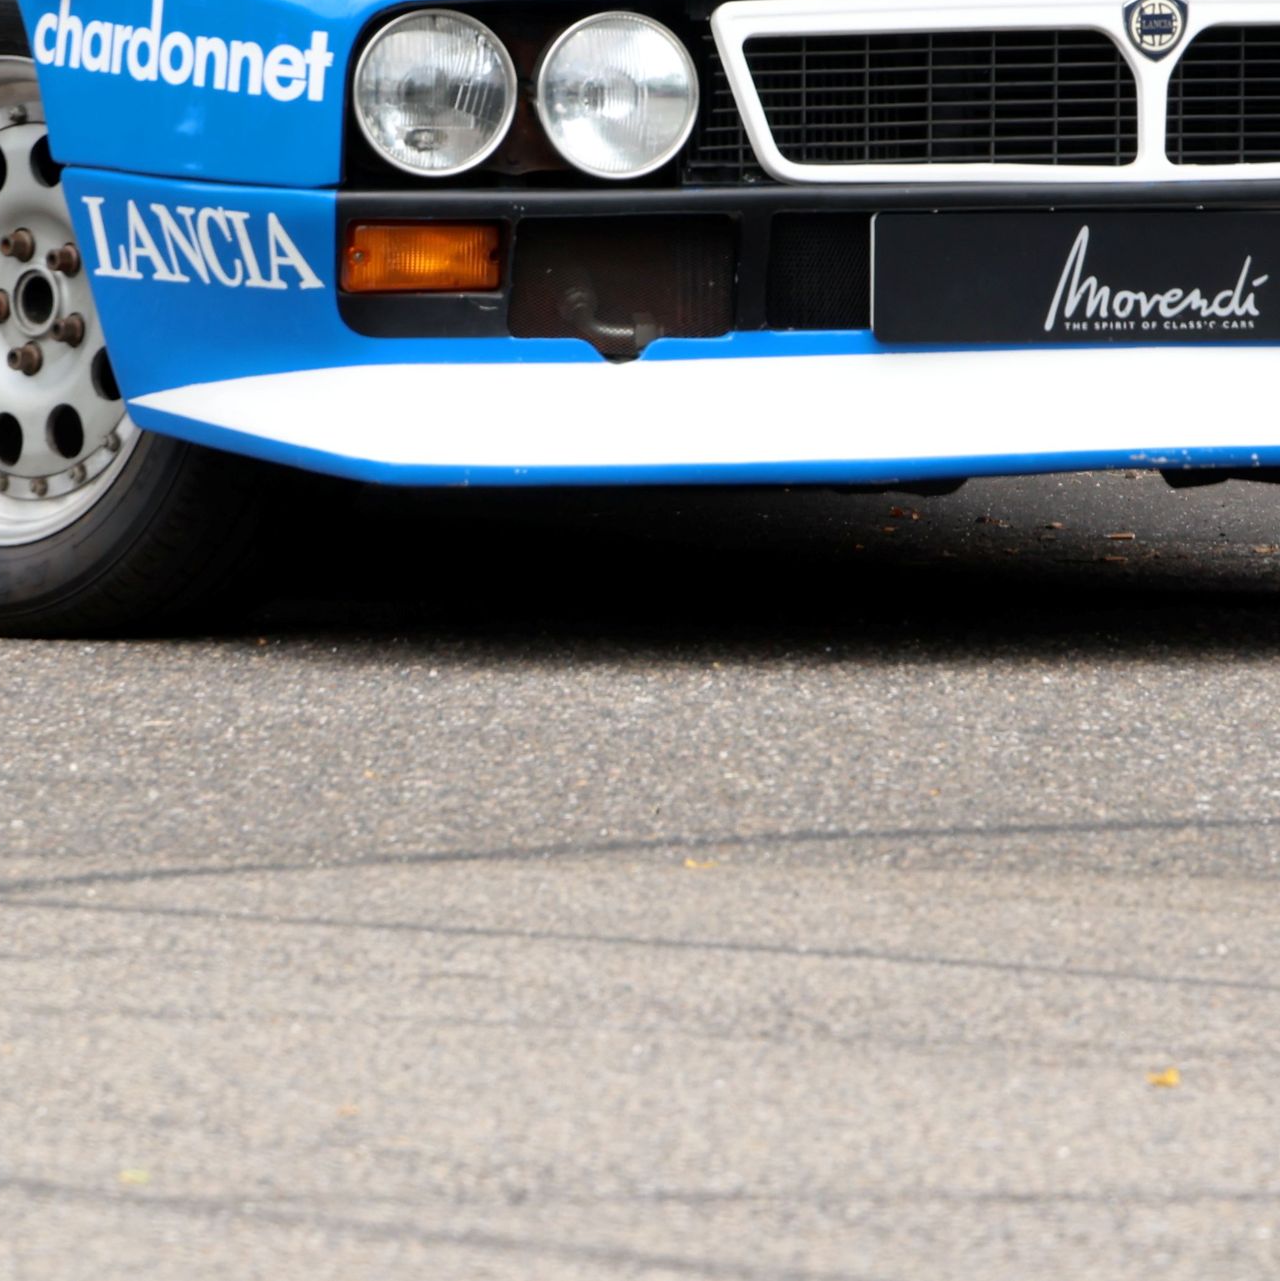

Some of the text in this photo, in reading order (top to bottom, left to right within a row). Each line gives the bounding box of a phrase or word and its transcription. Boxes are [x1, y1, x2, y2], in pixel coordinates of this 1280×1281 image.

[1141, 19, 1173, 30] LANCIA
[80, 195, 326, 291] LANCIA
[1064, 320, 1089, 331] THE
[1094, 320, 1136, 331] SPIRIT
[1141, 320, 1158, 330] OF
[1222, 320, 1255, 329] CARS
